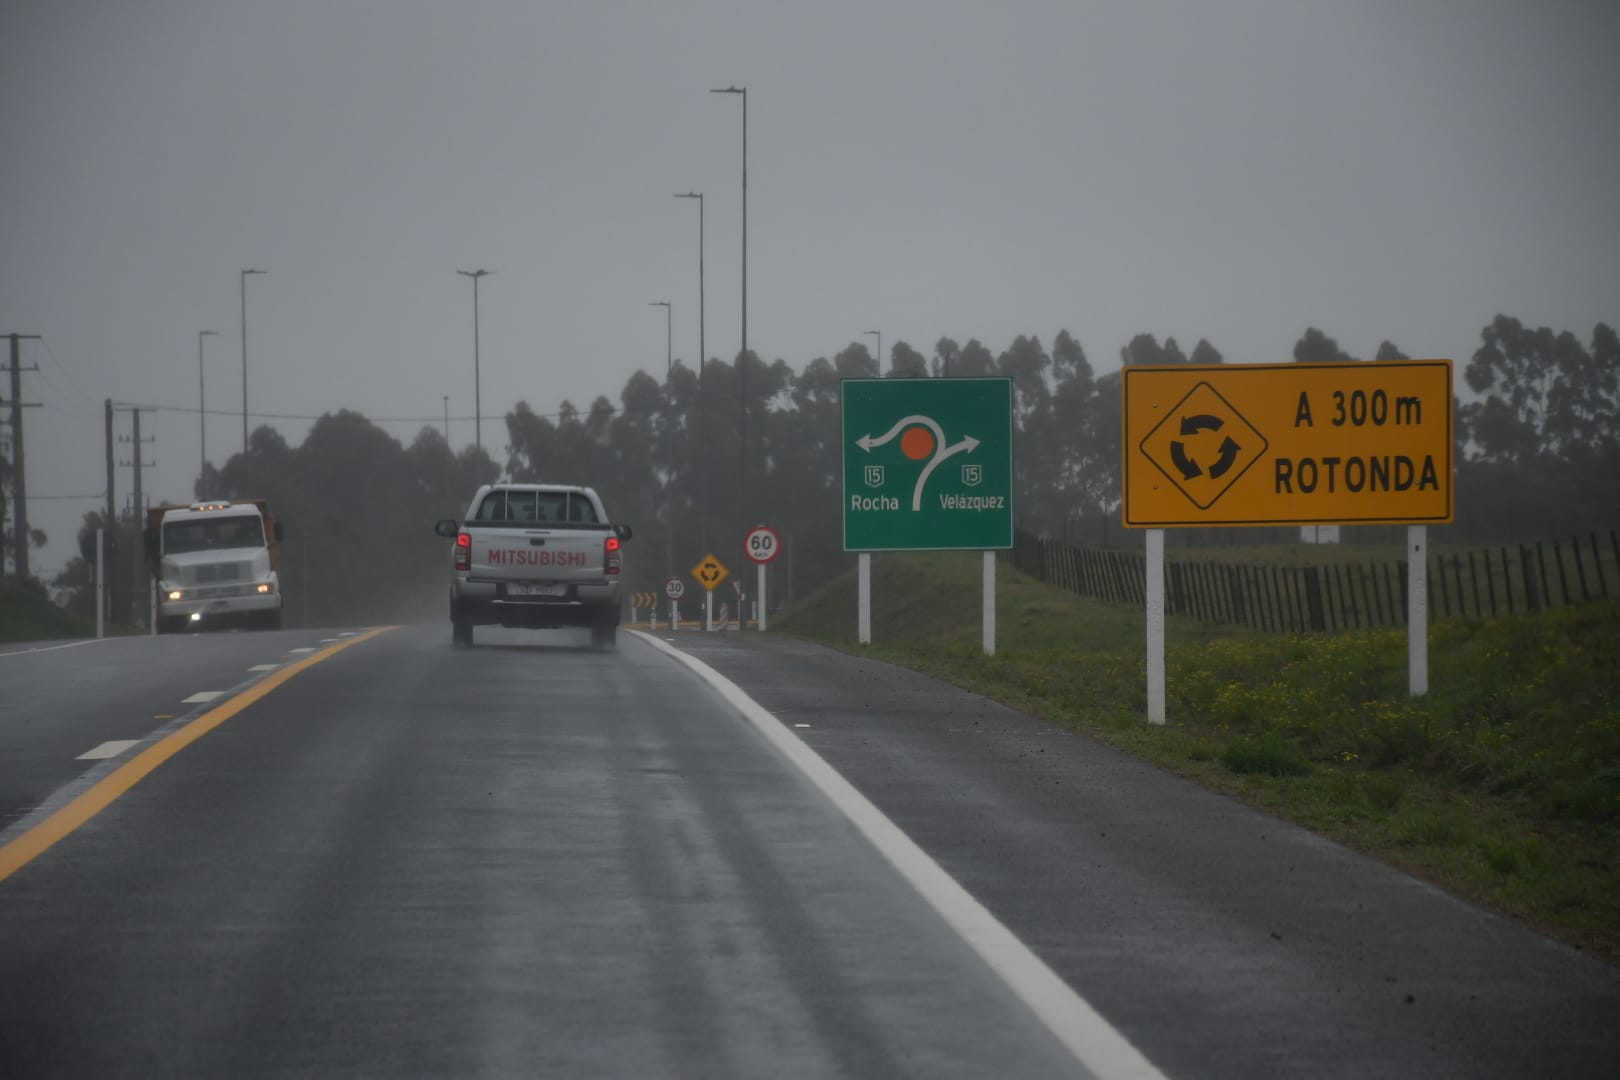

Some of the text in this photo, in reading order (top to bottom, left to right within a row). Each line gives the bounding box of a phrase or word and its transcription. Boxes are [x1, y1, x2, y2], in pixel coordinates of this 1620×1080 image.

[1295, 391, 1313, 427] A
[867, 468, 881, 483] 15
[965, 467, 979, 482] 15
[1275, 455, 1439, 494] ROTONDA
[851, 494, 899, 511] Rocha
[939, 493, 1004, 512] Velázquez
[751, 535, 771, 550] 60
[488, 549, 585, 567] MITSUBISHI
[669, 582, 681, 592] 30
